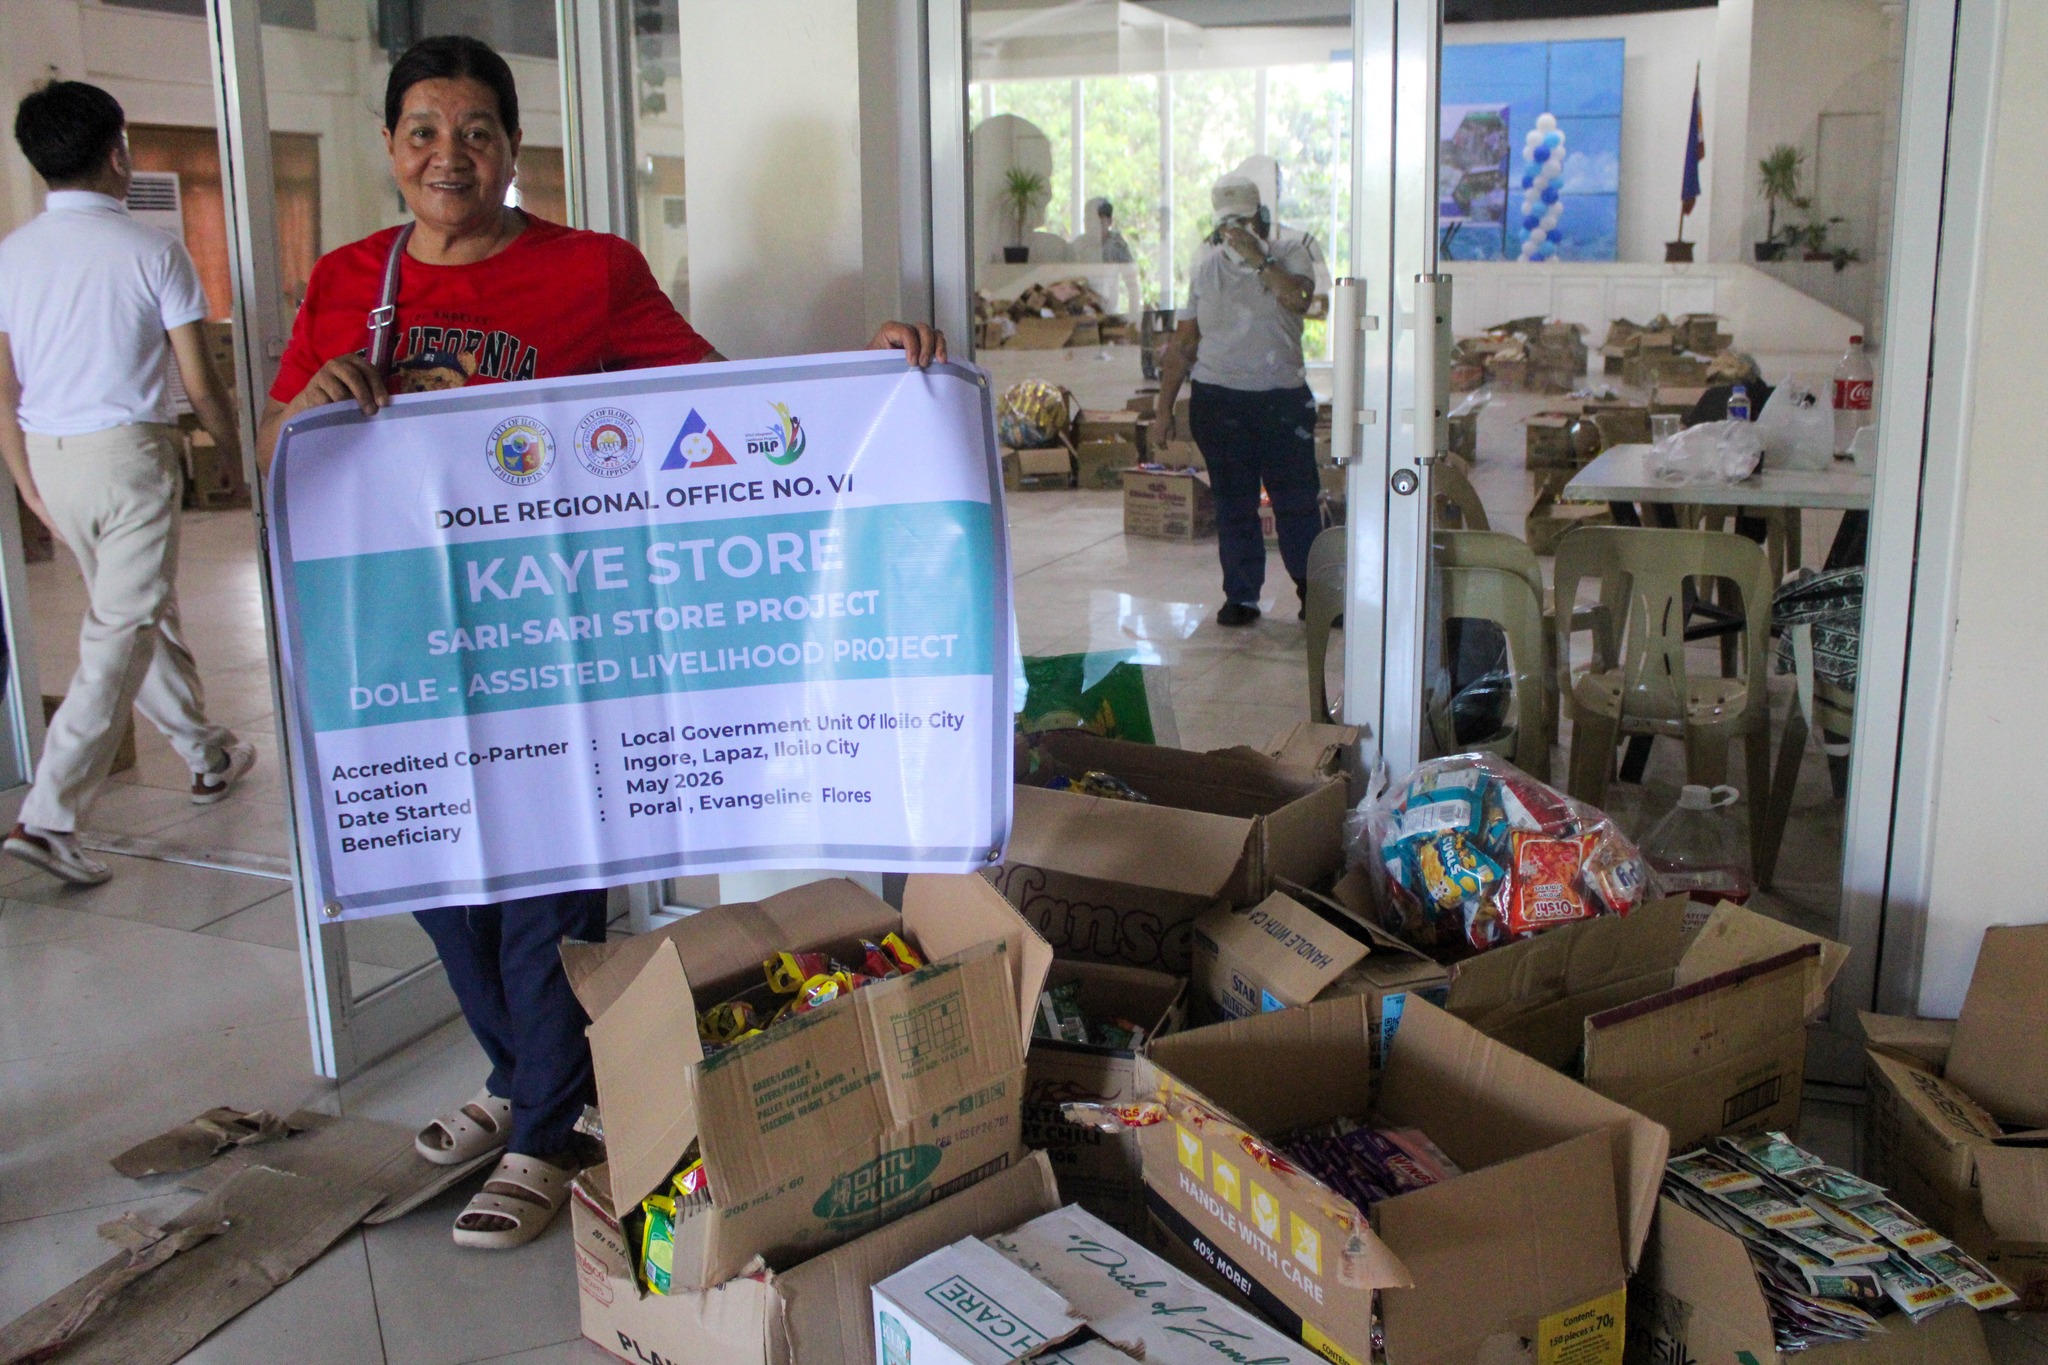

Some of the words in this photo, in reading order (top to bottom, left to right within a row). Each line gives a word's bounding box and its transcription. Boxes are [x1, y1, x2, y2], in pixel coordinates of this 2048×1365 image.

[747, 440, 779, 454] DILP
[434, 504, 510, 530] DOLE
[518, 490, 660, 522] REGIONAL
[666, 481, 765, 508] OFFICE
[773, 477, 821, 499] NO.
[827, 473, 854, 494] VI
[467, 545, 629, 603] KAYE
[646, 528, 844, 586] STORE
[427, 613, 603, 656] SARI-SARI
[612, 601, 726, 637] STORE
[736, 589, 880, 625] PROJECT
[350, 678, 440, 711] DOLE
[468, 658, 621, 698] ASSISTED
[630, 640, 825, 680] LIVELIHOOD
[833, 633, 958, 664] PROJECT
[621, 725, 676, 749] Local
[681, 716, 812, 742] Government
[817, 713, 853, 732] Unit
[857, 713, 876, 731] Of
[879, 712, 923, 730] Iloilo
[928, 710, 965, 732] City
[331, 752, 449, 782] Accredited
[454, 740, 569, 768] Co-Partner
[623, 750, 697, 773] Ingore,
[702, 744, 769, 766] Lapaz,
[774, 740, 822, 759] Iloilo
[826, 738, 860, 759] City
[335, 780, 429, 805] Location
[626, 776, 670, 799] May
[674, 770, 724, 790] 2026
[628, 797, 682, 819] Poral
[699, 789, 812, 812] Evangeline
[821, 786, 872, 805] Flores
[338, 810, 390, 830] Date
[395, 798, 473, 822] Started
[341, 825, 462, 853] Beneficiary
[1534, 899, 1573, 917] Oishi
[1261, 918, 1292, 943] WITH
[1284, 933, 1334, 970] HANDLE
[1232, 973, 1257, 1006] STAR
[854, 1148, 916, 1190] DATU
[724, 1203, 749, 1219] 200
[789, 1176, 805, 1190] 60
[853, 1173, 905, 1210] PUTI
[1179, 1172, 1237, 1234] HANDLE
[1239, 1222, 1279, 1270] WITH
[1281, 1257, 1324, 1306] CARE
[1192, 1237, 1216, 1265] 40%
[1216, 1256, 1253, 1297] MORE!
[939, 1281, 1017, 1338] CARE
[1563, 1308, 1596, 1327] Content:
[1564, 1326, 1589, 1344] pieces
[1596, 1313, 1615, 1331] 70g
